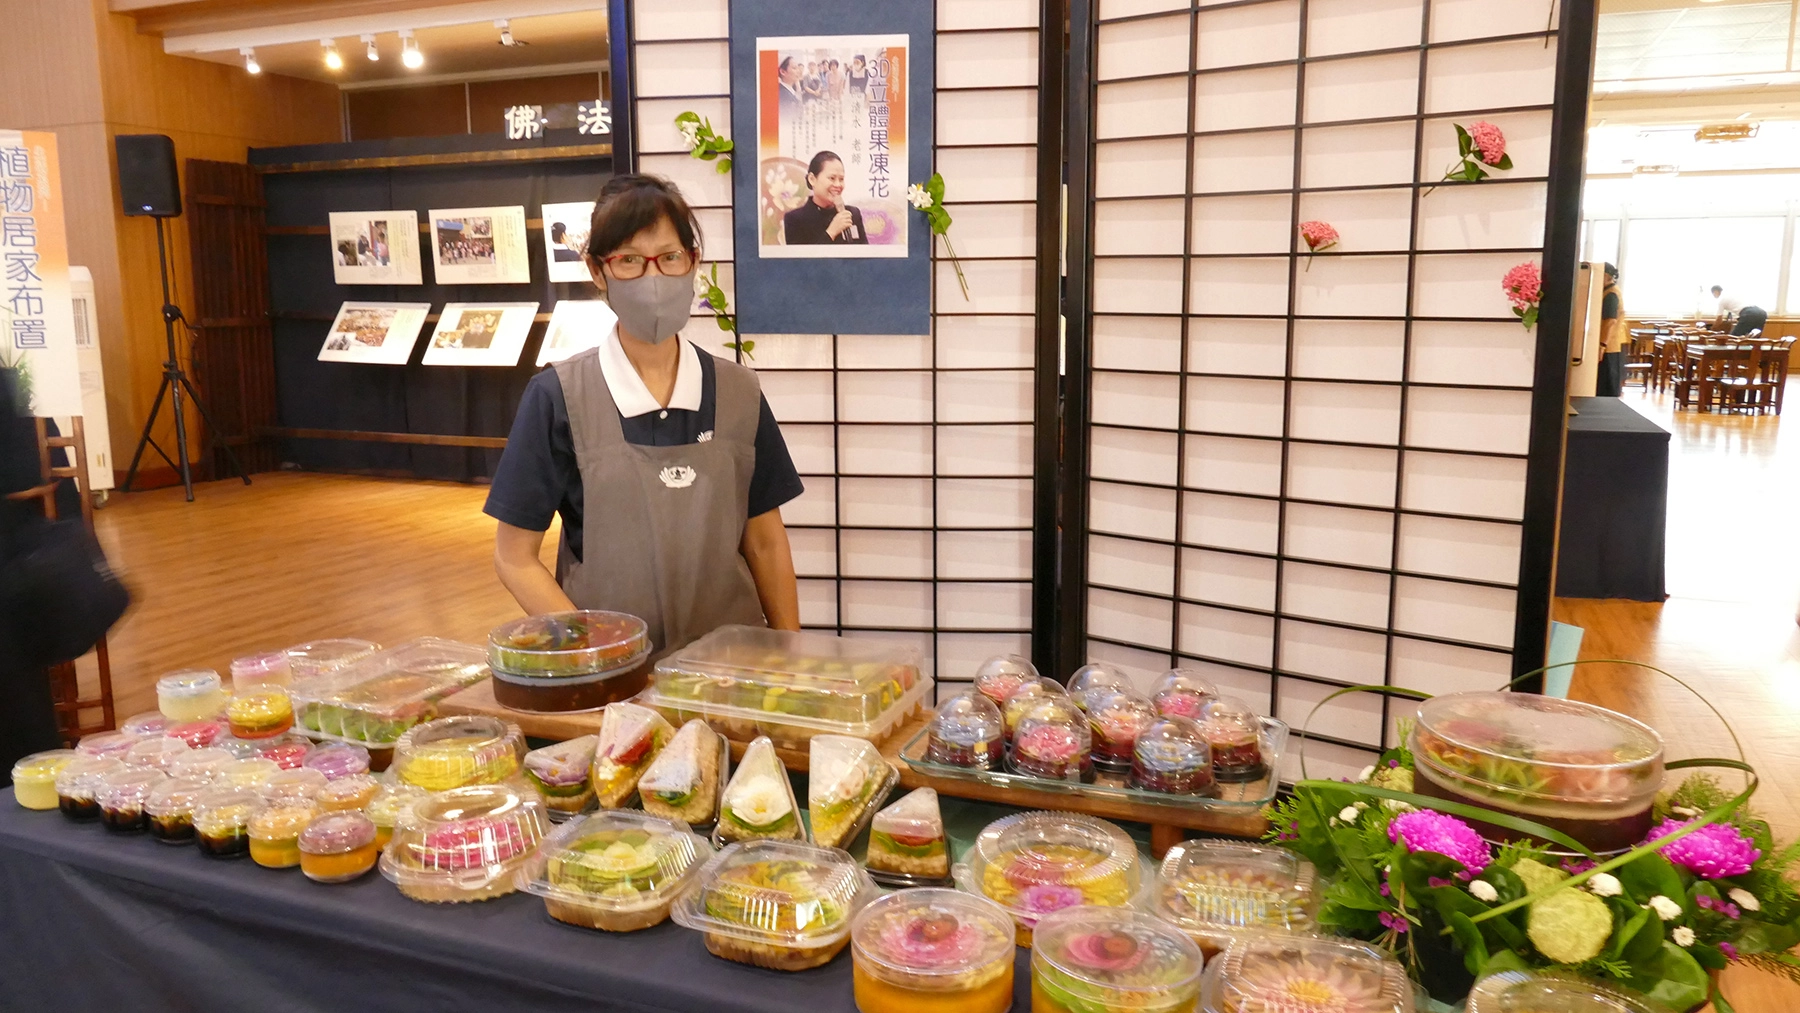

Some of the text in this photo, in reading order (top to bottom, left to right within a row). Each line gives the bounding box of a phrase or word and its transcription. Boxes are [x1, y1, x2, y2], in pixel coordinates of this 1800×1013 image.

[504, 99, 612, 140] 佛 法
[868, 58, 890, 199] 3D立體果凍花
[0, 145, 48, 350] 植物居家布置
